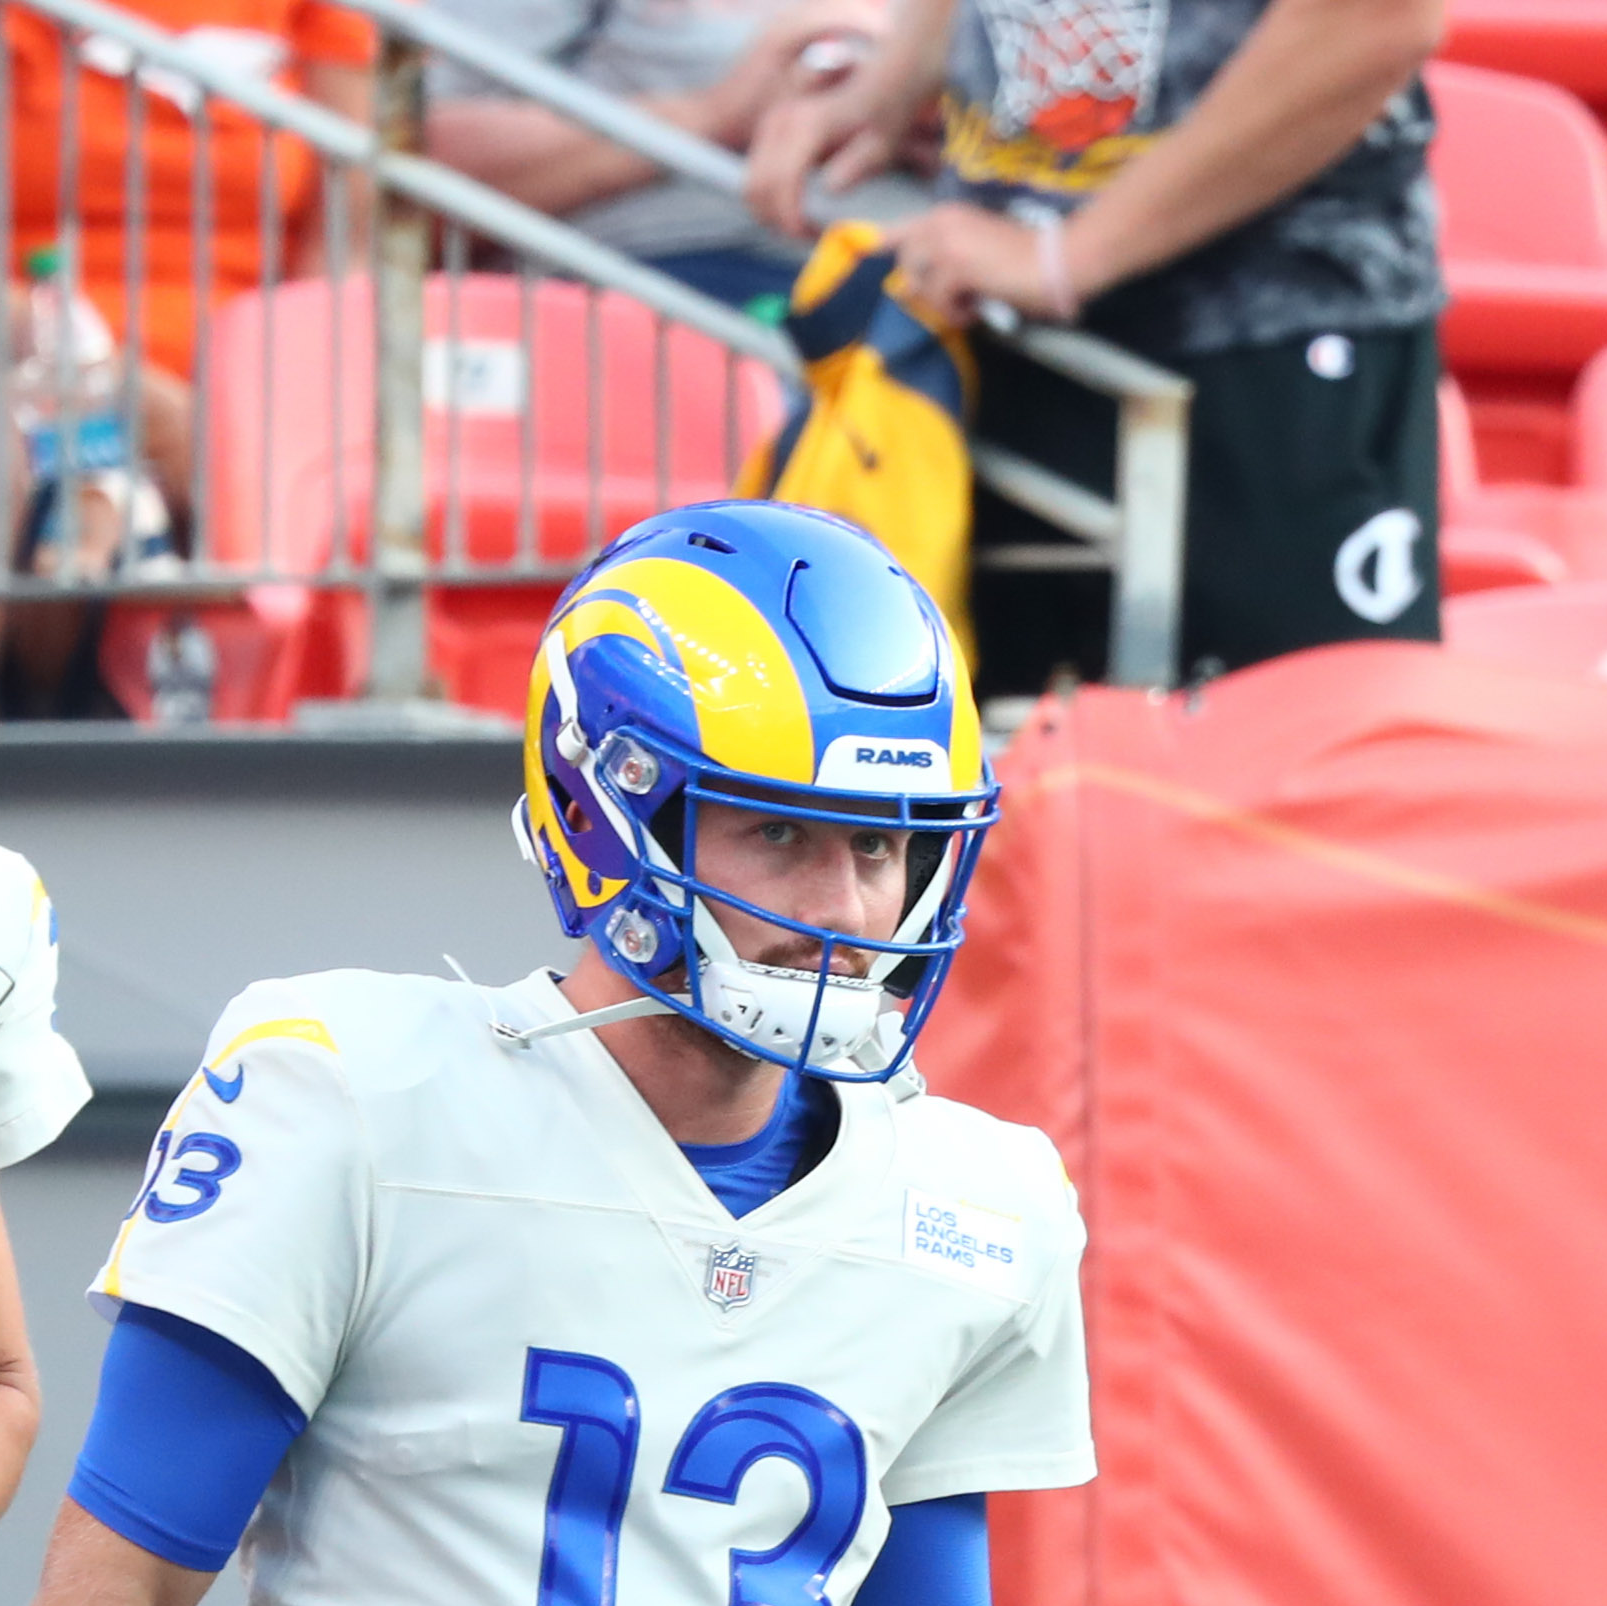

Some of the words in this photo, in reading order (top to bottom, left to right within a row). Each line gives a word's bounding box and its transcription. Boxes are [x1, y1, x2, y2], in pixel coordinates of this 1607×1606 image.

[855, 747, 933, 769] RAMS
[121, 1130, 242, 1224] 13
[915, 1201, 958, 1228] LOS
[915, 1220, 1014, 1264] ANGELES
[915, 1236, 976, 1269] RAMS
[713, 1268, 749, 1298] NFL
